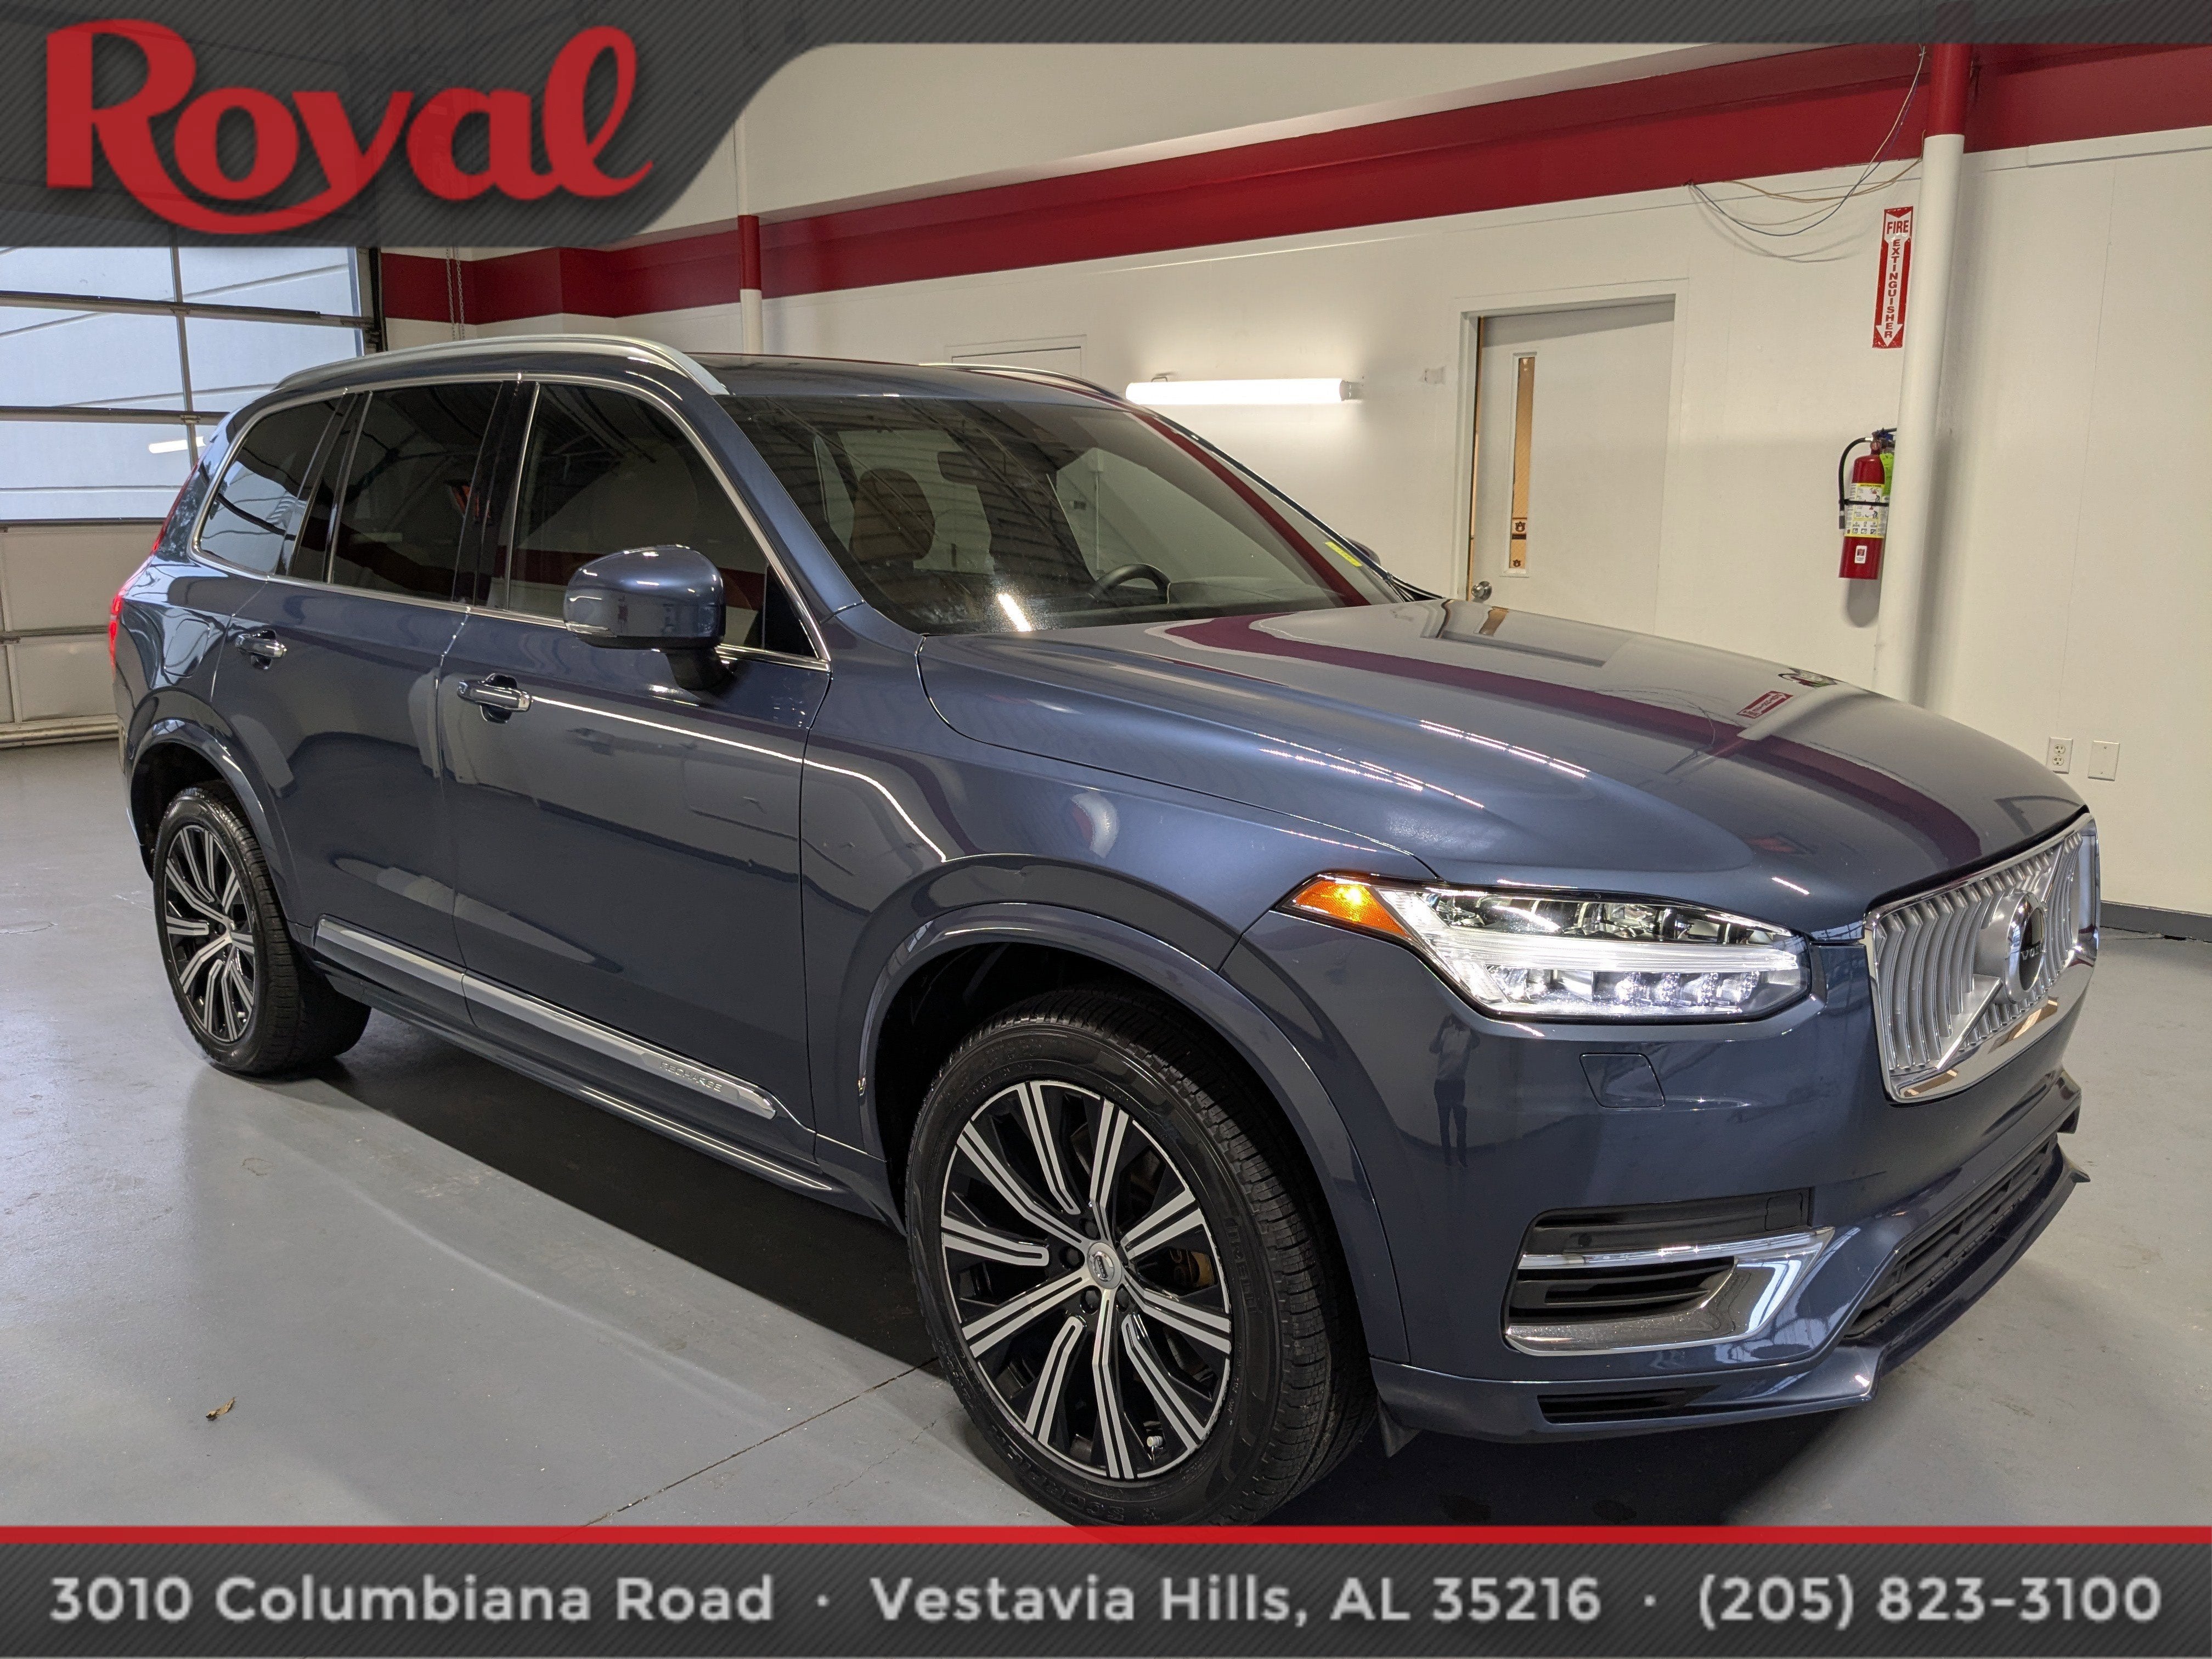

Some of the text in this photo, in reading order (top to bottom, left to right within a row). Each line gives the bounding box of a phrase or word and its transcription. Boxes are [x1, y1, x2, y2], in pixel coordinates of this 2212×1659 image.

[1887, 219, 1909, 235] FIRE
[1884, 239, 1901, 338] EXTINGUISHER
[660, 1061, 723, 1092] RECHARGE
